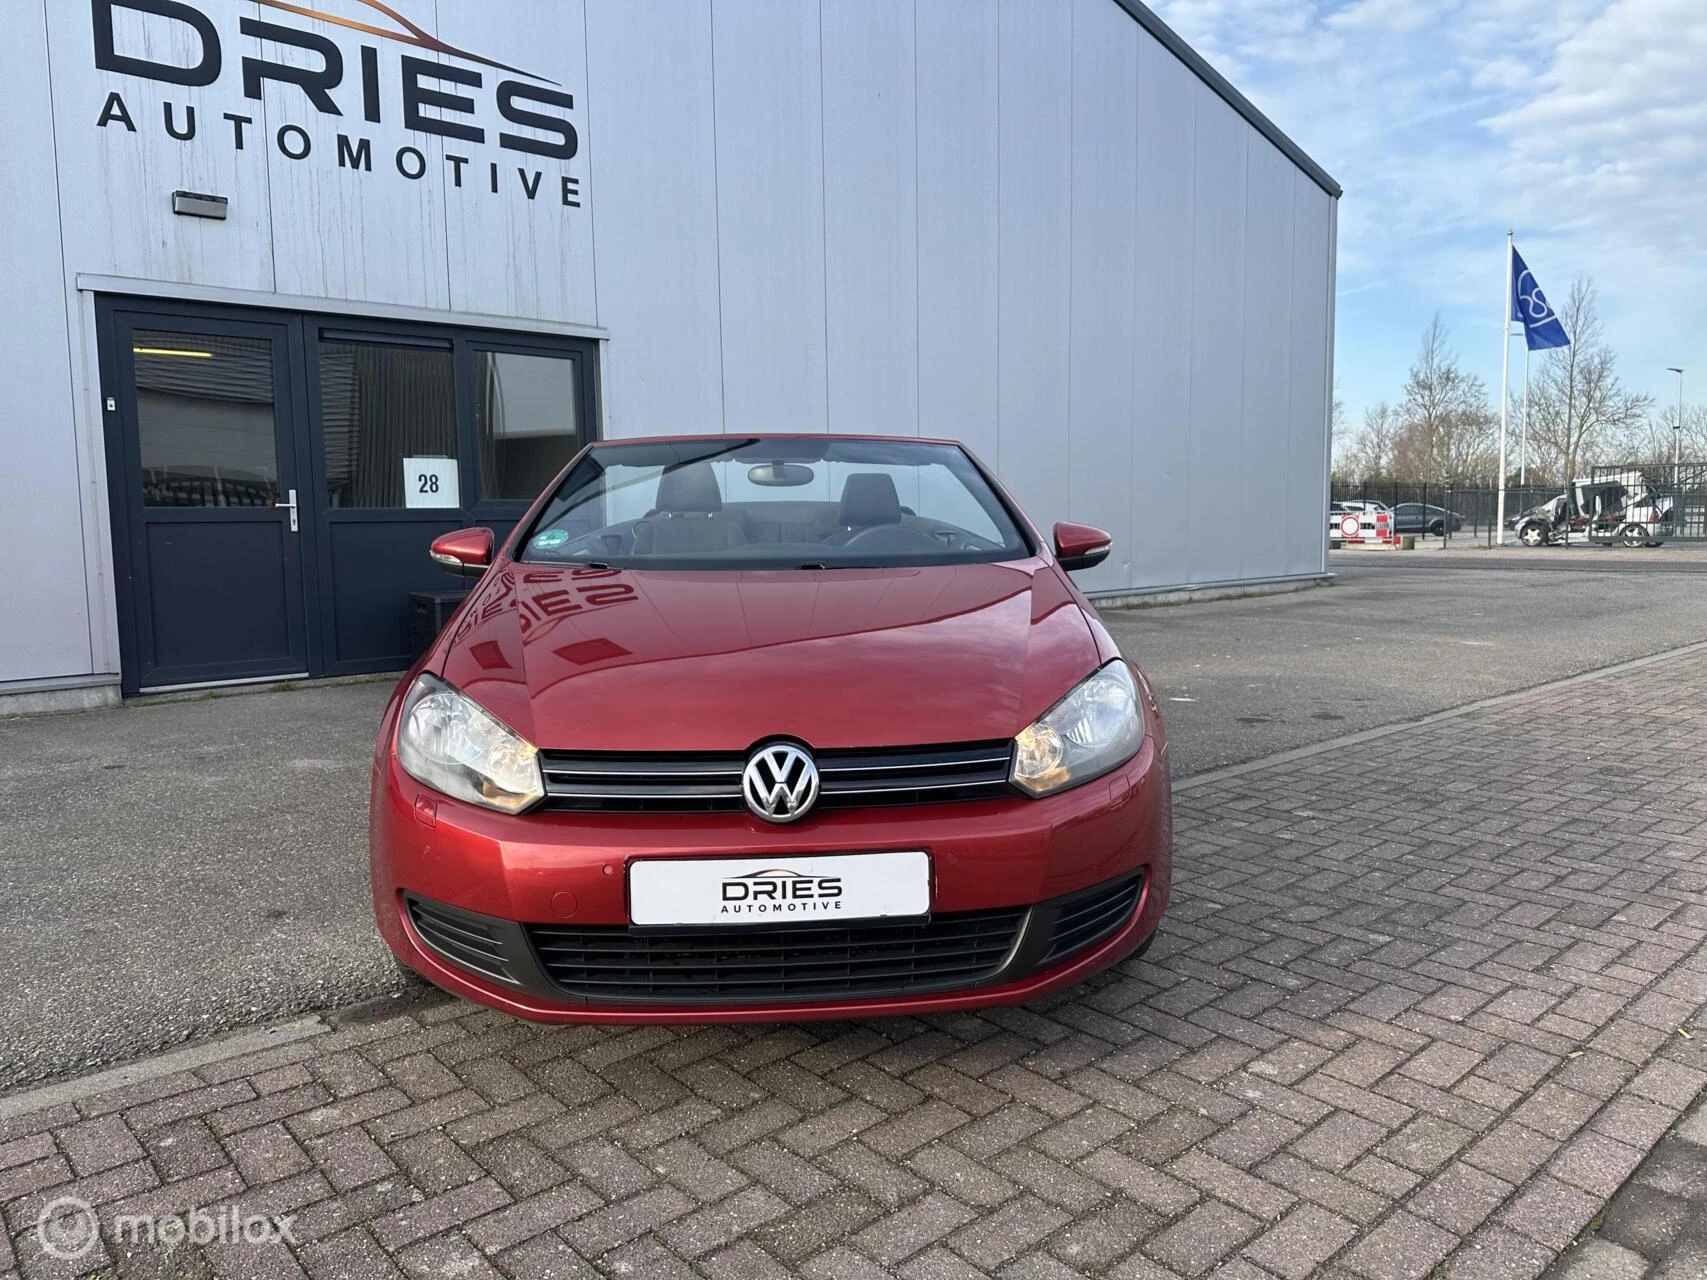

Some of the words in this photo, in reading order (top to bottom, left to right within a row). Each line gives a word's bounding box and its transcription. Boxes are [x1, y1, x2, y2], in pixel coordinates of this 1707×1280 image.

[93, 0, 578, 160] DRIES
[96, 91, 581, 208] AUTOMOTIVE
[418, 474, 439, 493] 28
[744, 747, 819, 822] VW
[721, 901, 842, 914] AUTOMOTIVE
[722, 878, 842, 901] DRIES
